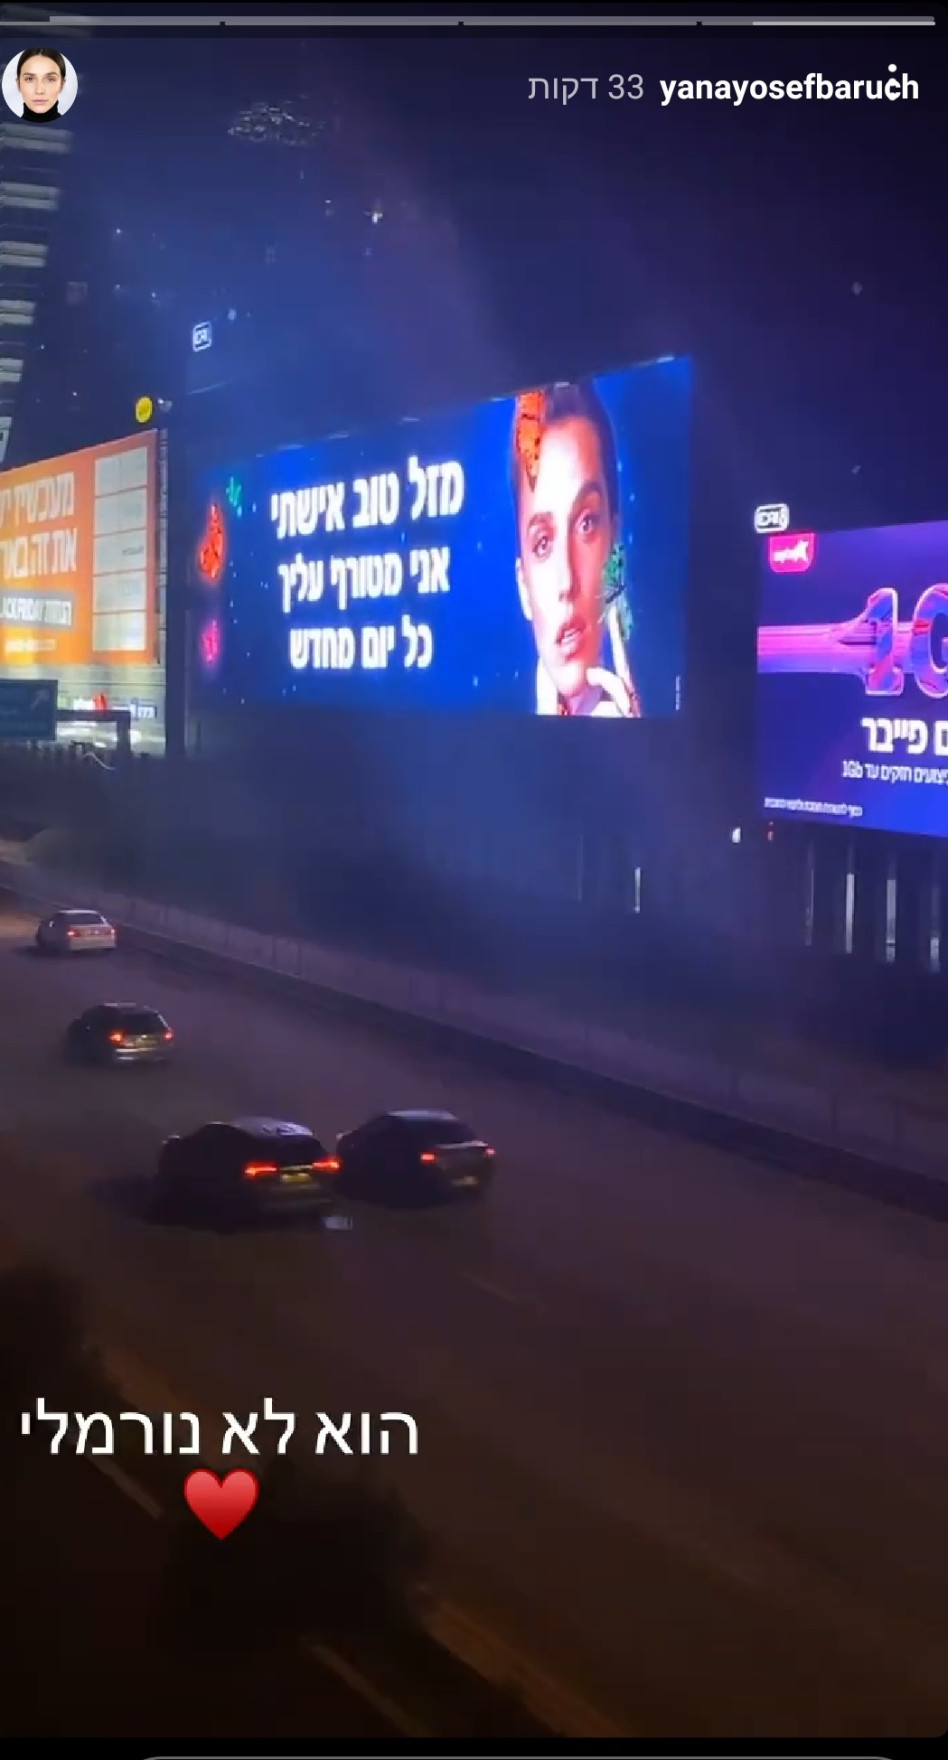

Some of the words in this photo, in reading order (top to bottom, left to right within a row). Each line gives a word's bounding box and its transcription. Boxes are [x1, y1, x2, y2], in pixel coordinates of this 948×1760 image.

[271, 481, 345, 539] אישתי
[352, 472, 400, 528] טוב
[408, 455, 464, 520] מזל
[277, 553, 325, 613] עליך
[330, 553, 403, 610] מטורף
[410, 547, 450, 594] אני
[289, 627, 356, 669] מחדש
[361, 625, 395, 669] יום
[402, 614, 434, 669] כל
[861, 718, 929, 754] פייבר
